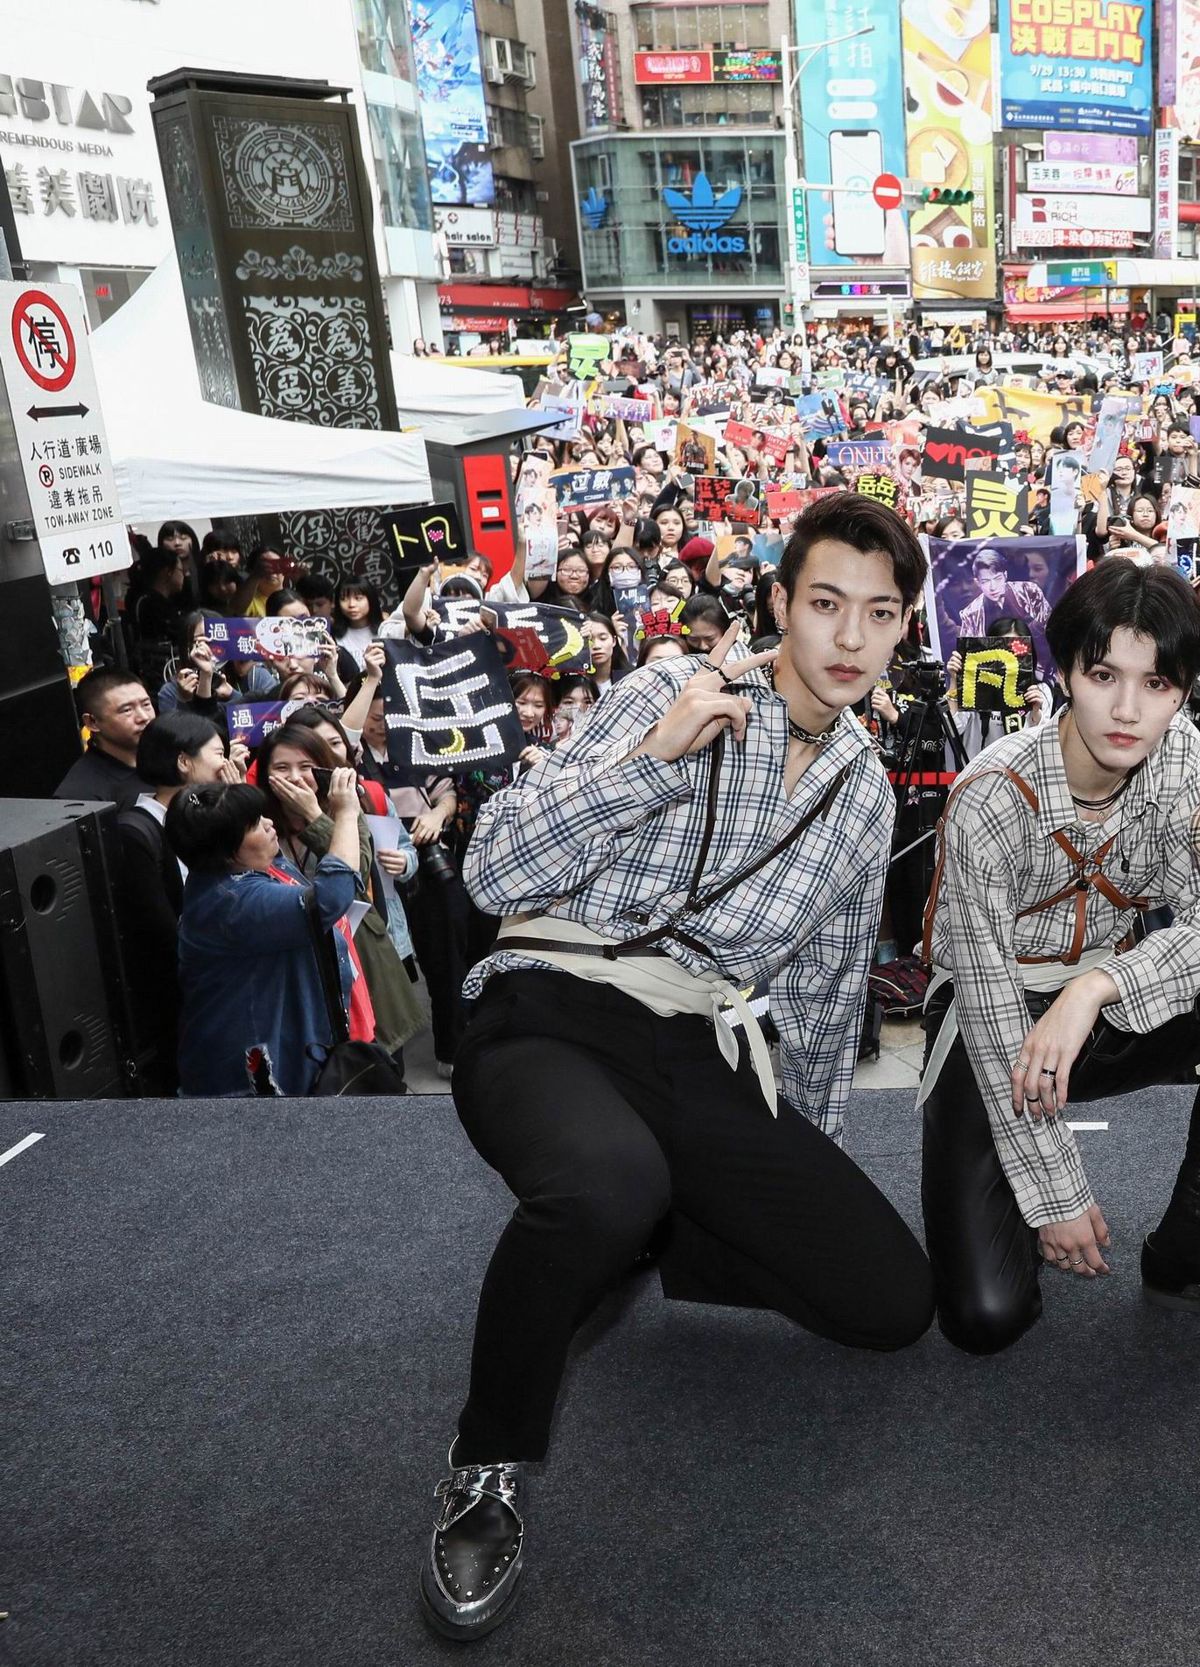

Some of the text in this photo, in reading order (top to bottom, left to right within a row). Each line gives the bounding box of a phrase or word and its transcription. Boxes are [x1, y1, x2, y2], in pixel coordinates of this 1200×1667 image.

[1011, 0, 1144, 34] COSPLAY
[1011, 24, 1144, 64] 決戰西門町
[77, 143, 114, 158] MEDIA
[445, 231, 492, 242] hair salon
[667, 233, 745, 255] adidas
[1105, 266, 1113, 281] 6
[28, 315, 62, 370] 停
[59, 463, 102, 480] SIDEWALK
[48, 485, 103, 510] 違者拖吊
[44, 506, 114, 530] TOW-AWAY ZONE
[88, 539, 114, 561] 110
[962, 648, 1026, 709] 凡
